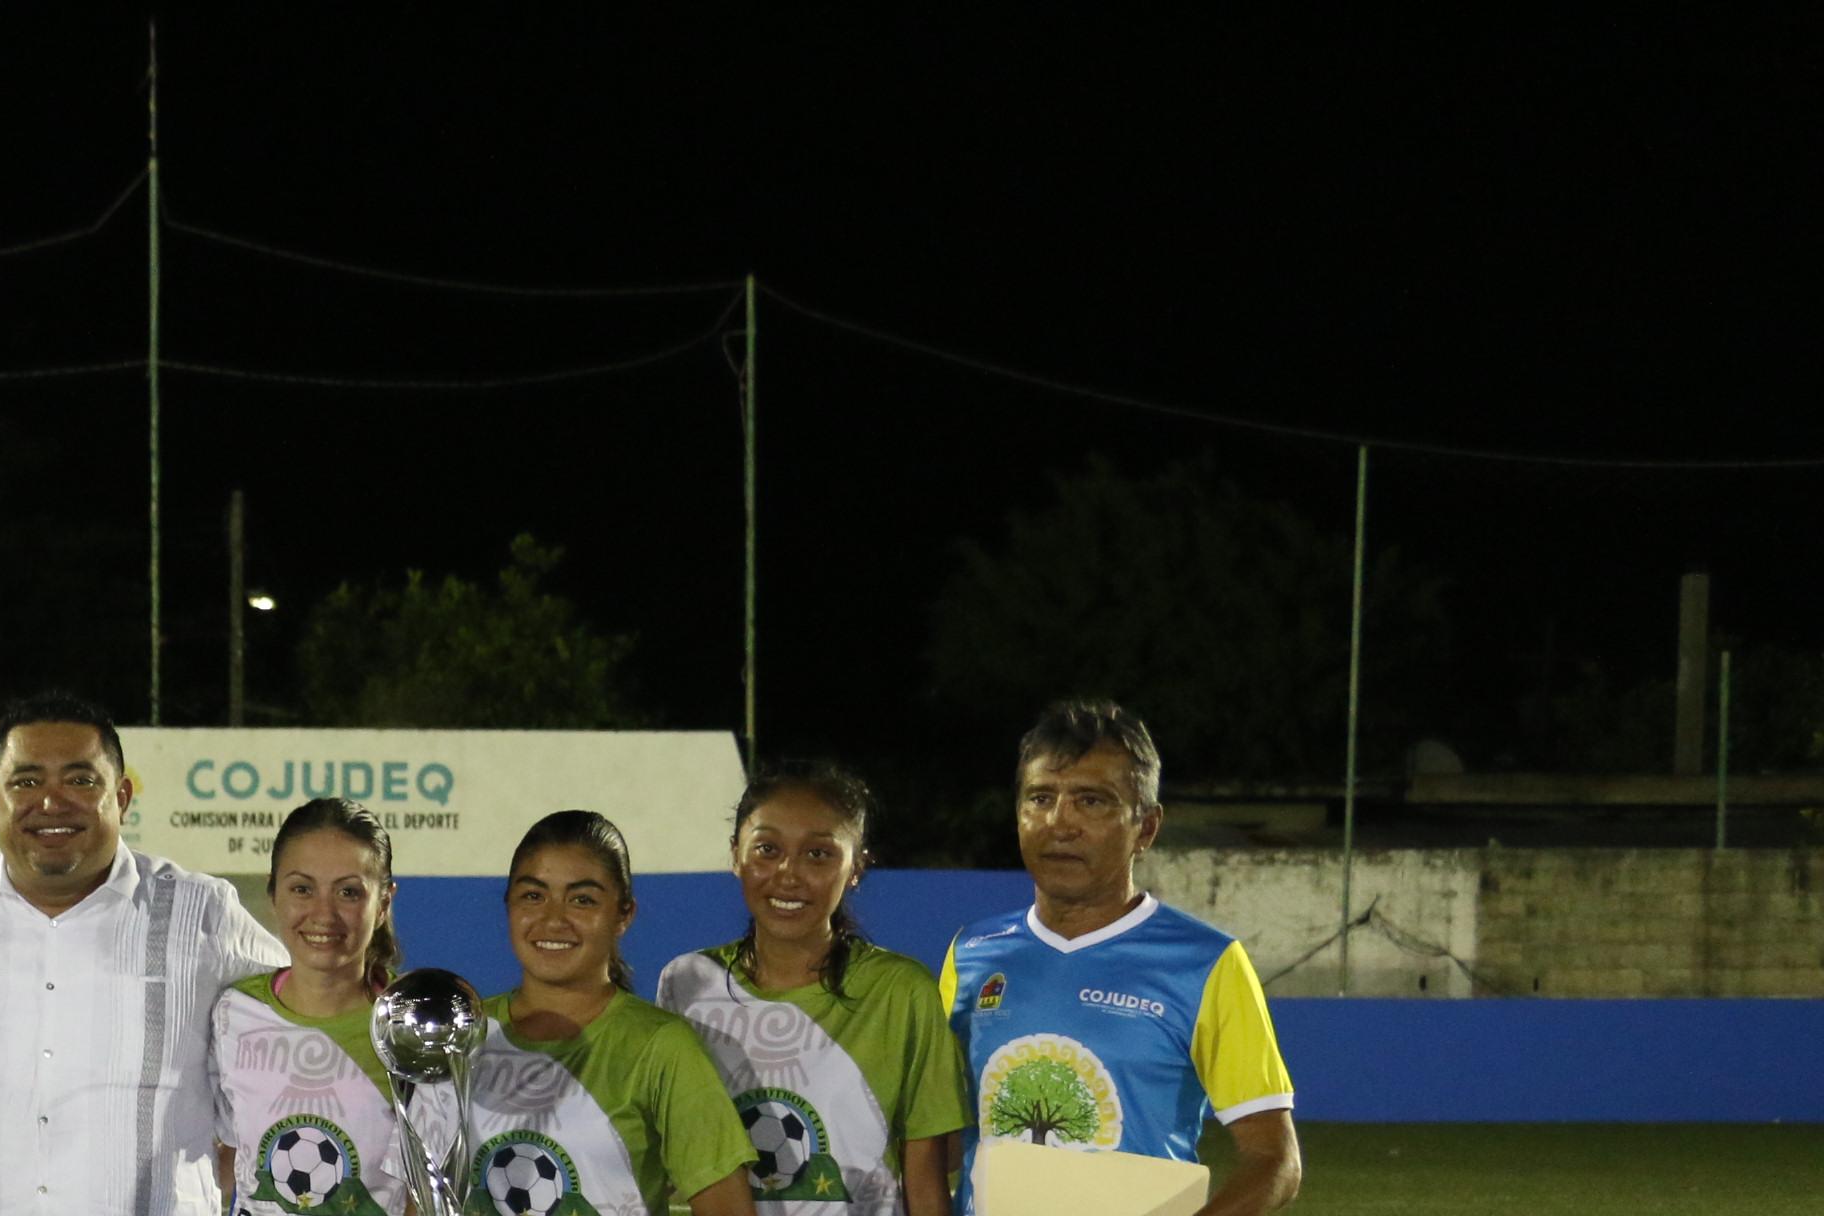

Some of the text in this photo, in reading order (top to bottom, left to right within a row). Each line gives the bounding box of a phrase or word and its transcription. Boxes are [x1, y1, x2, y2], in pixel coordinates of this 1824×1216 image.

[186, 760, 455, 806] COJUDEQ
[170, 812, 238, 828] COMISION
[242, 812, 275, 828] PARA
[385, 813, 459, 830] EL DEPORTE
[1079, 988, 1165, 1018] COJUDEQ
